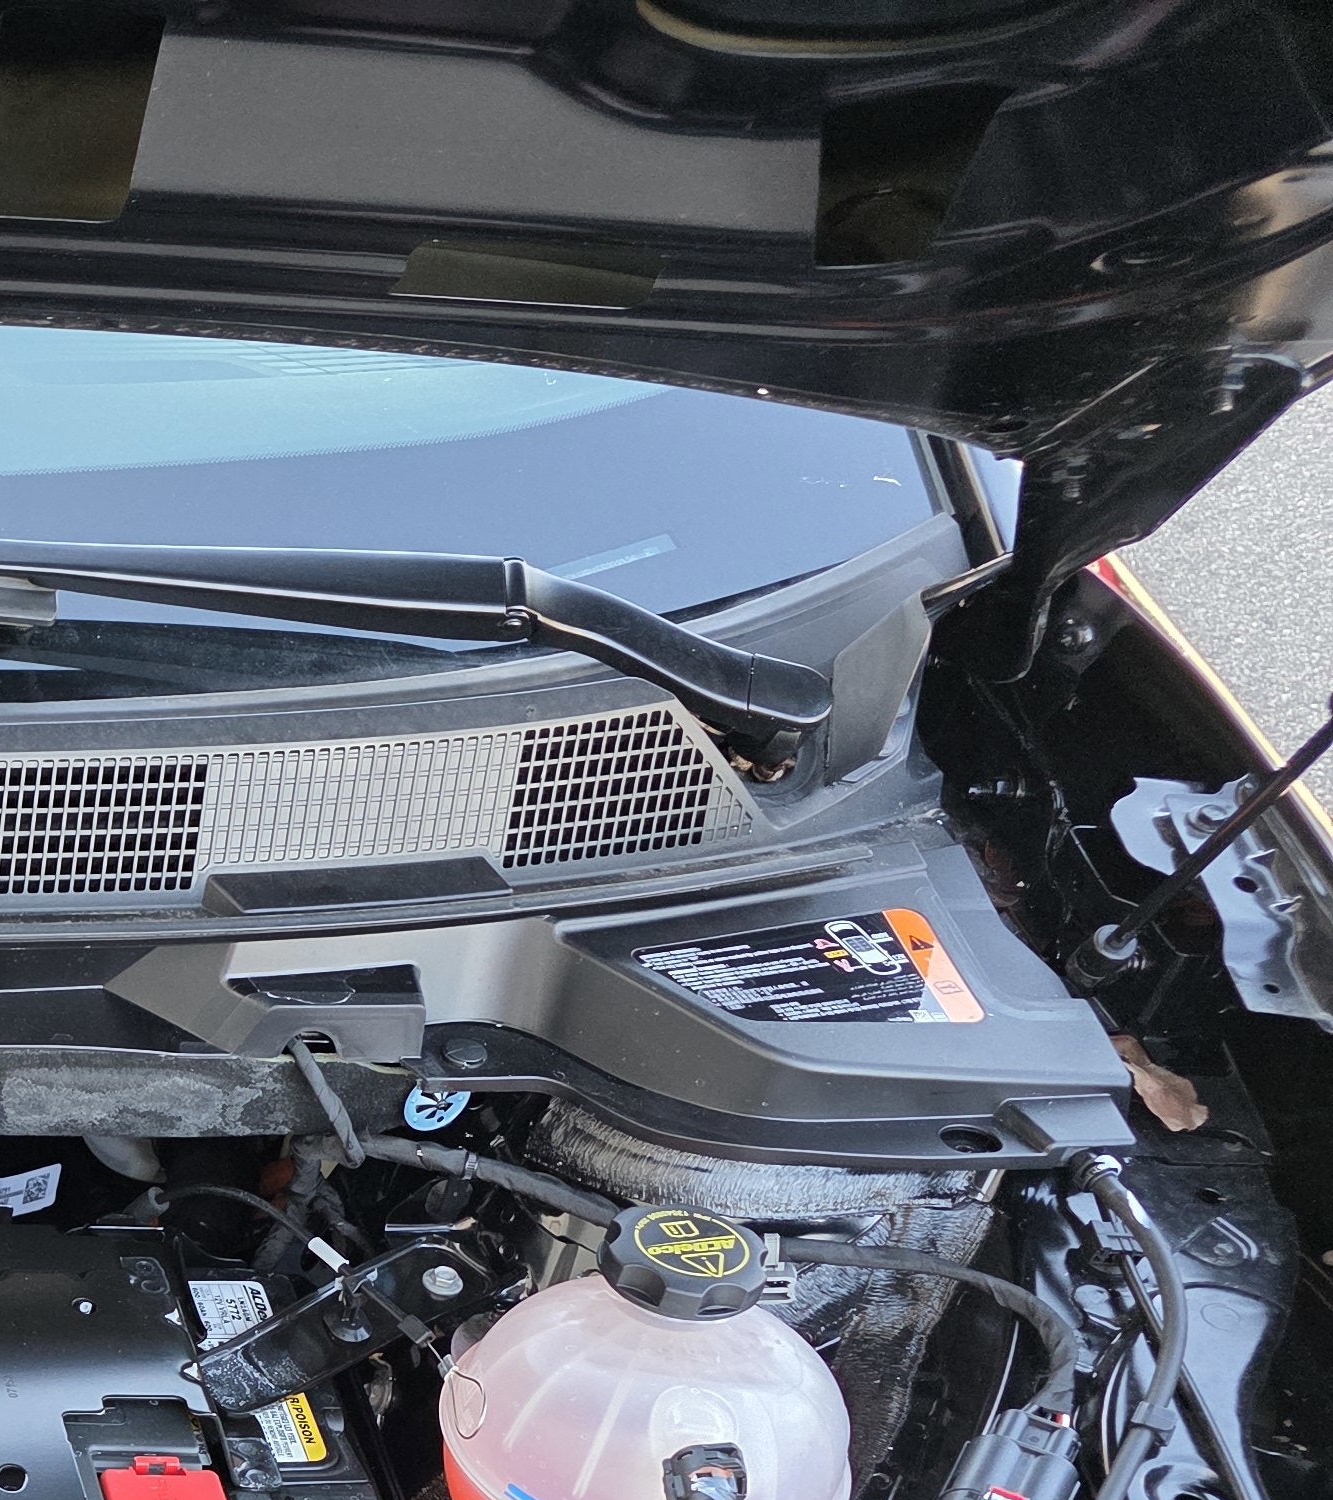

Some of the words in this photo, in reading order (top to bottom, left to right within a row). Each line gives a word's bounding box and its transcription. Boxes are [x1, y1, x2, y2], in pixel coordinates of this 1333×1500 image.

[646, 1239, 736, 1256] ACDelco
[225, 1298, 242, 1321] 5772
[248, 1287, 268, 1322] ACDe
